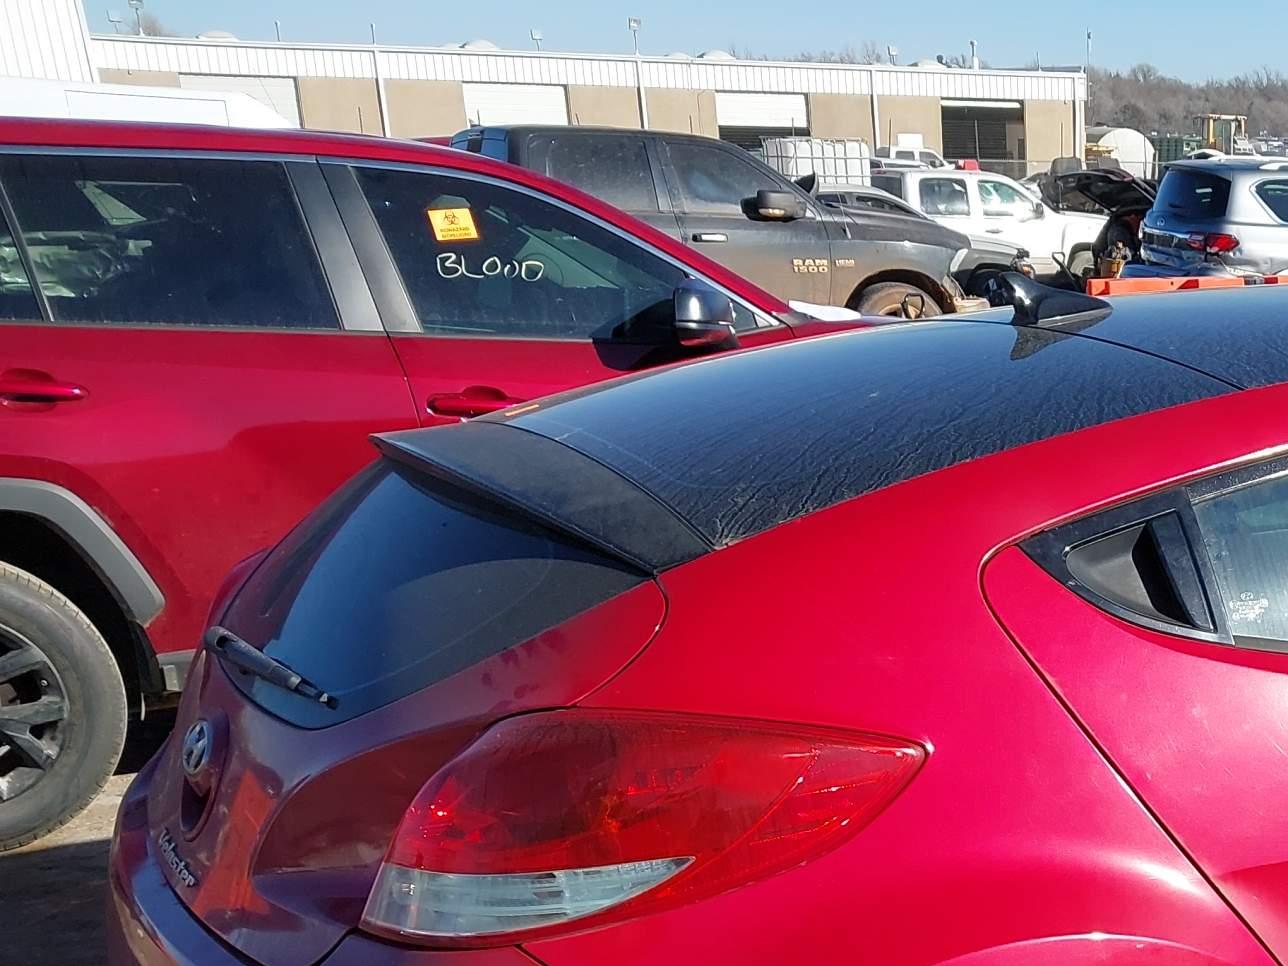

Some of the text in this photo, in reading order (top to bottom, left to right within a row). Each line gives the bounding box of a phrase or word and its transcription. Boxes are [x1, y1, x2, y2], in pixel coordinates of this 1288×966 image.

[792, 258, 828, 266] RAM
[436, 252, 544, 282] BLOOD
[792, 265, 828, 273] 1500
